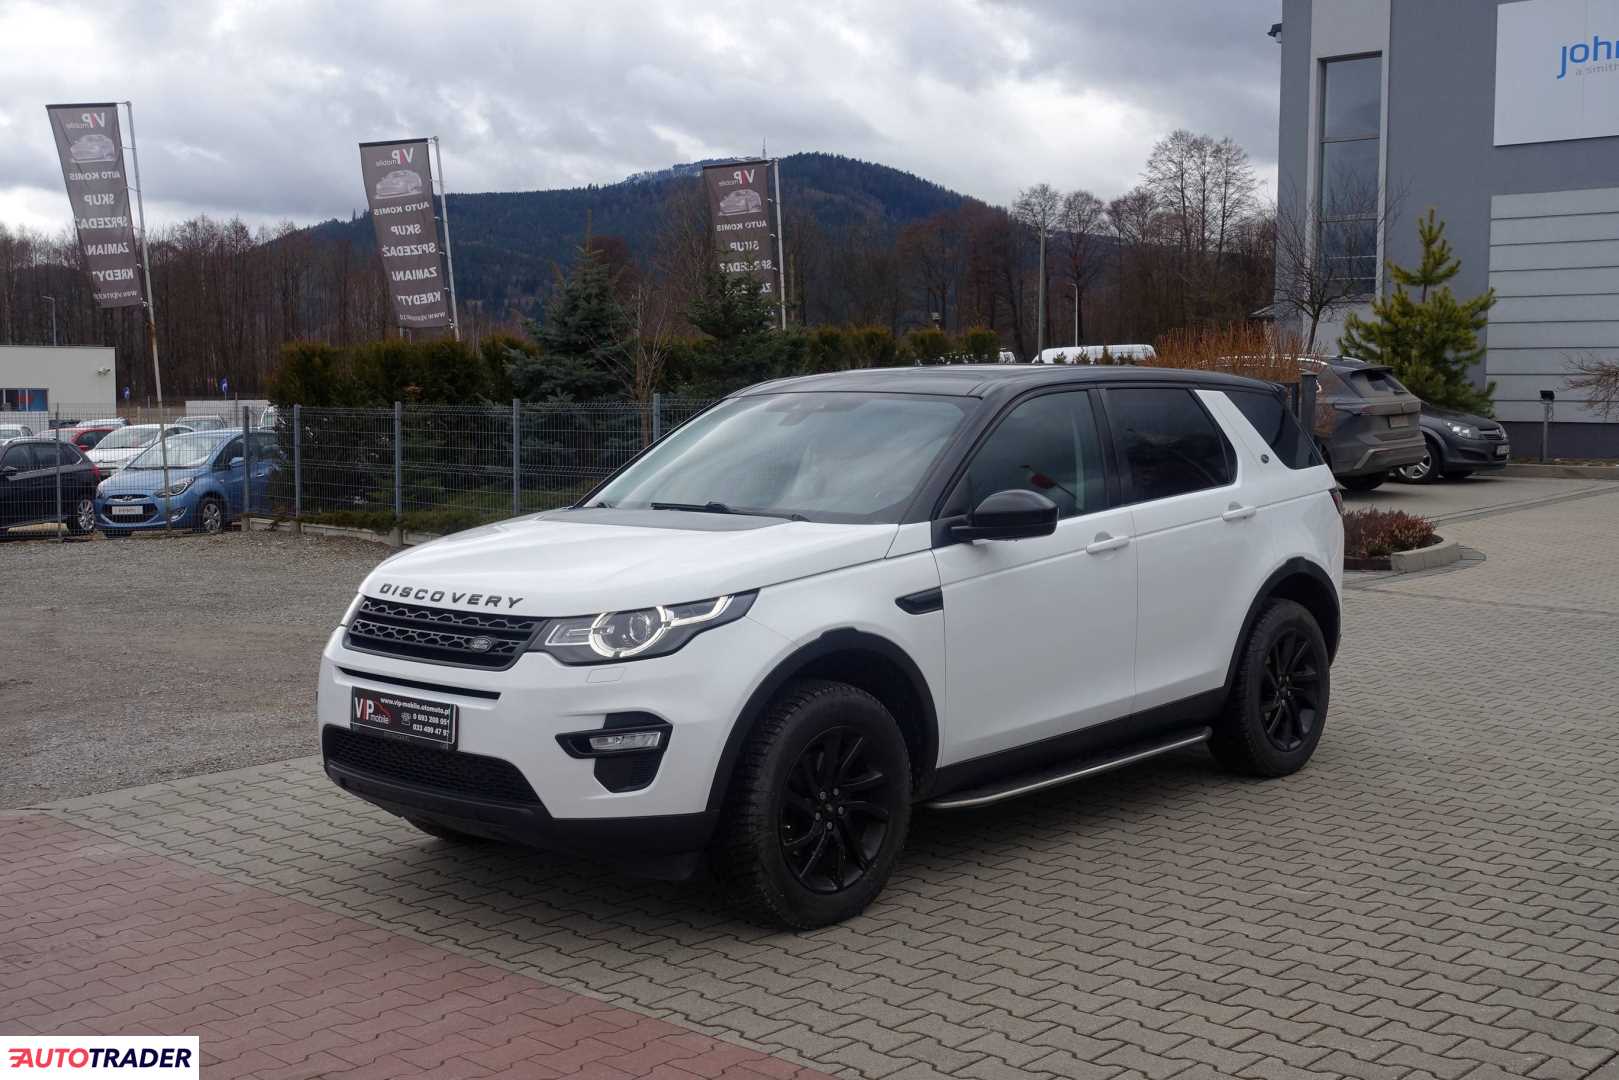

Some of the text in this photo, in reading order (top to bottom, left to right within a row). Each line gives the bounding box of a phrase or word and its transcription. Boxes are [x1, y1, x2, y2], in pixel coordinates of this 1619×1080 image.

[379, 583, 524, 609] DISCOVERY
[370, 713, 390, 725] mobile
[434, 728, 442, 736] 47
